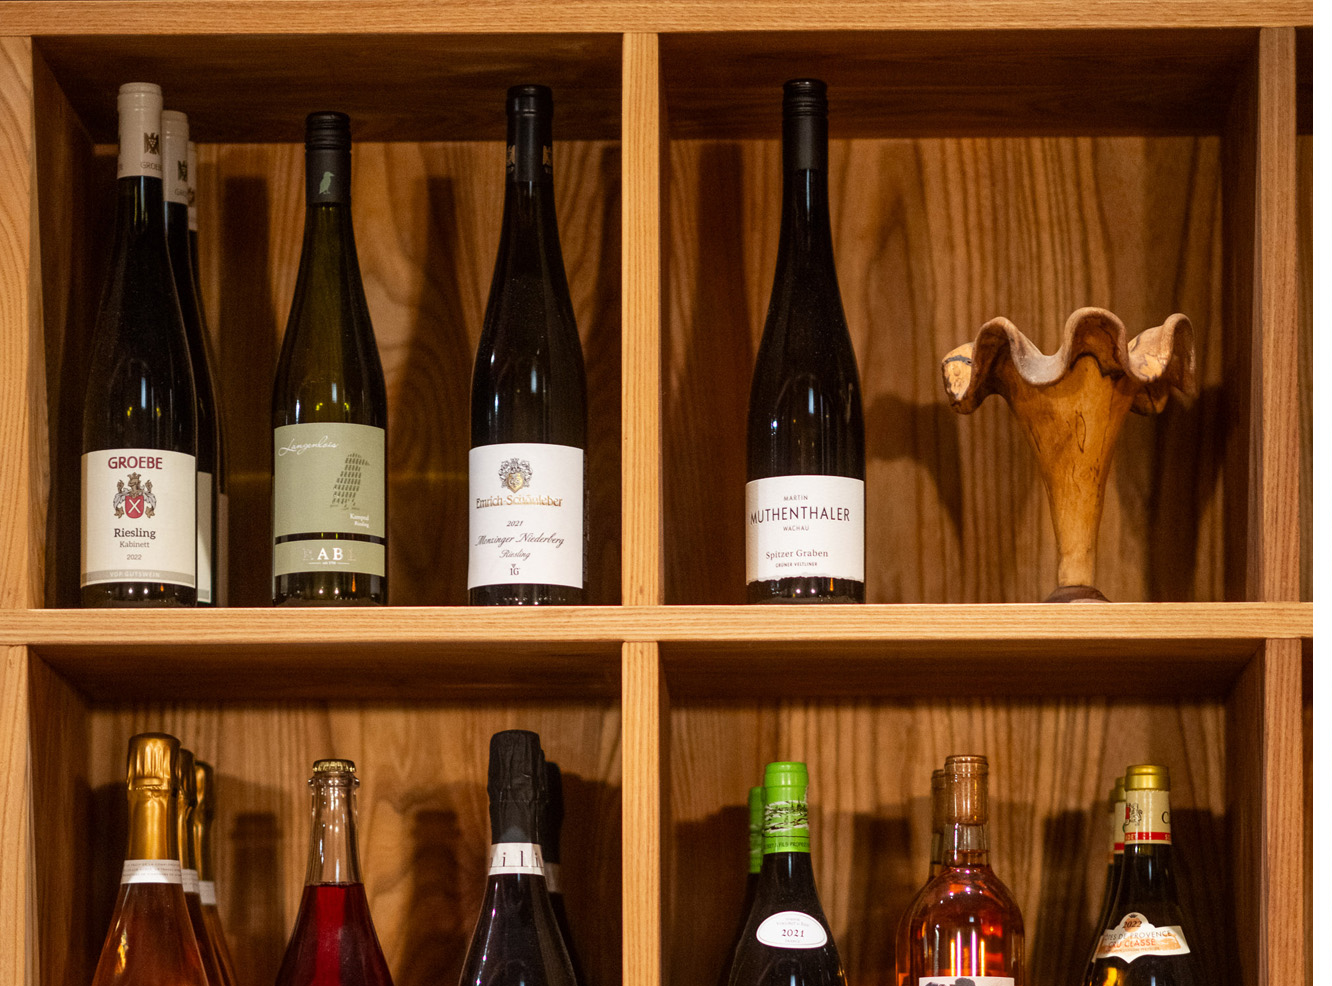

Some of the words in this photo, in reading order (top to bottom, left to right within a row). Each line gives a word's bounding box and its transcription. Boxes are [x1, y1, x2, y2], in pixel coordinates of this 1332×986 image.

[108, 456, 163, 470] GROEBE
[750, 506, 850, 525] MUTHENTHALER
[114, 528, 156, 540] Riesling
[119, 540, 150, 548] Kabinett
[516, 532, 564, 549] Niederberg
[499, 550, 531, 561] Riesling
[765, 551, 794, 561] Spitzer
[796, 549, 828, 558] Graben
[1121, 920, 1143, 929] 2022
[781, 929, 805, 938] 2021
[1129, 930, 1172, 939] PROVENCE
